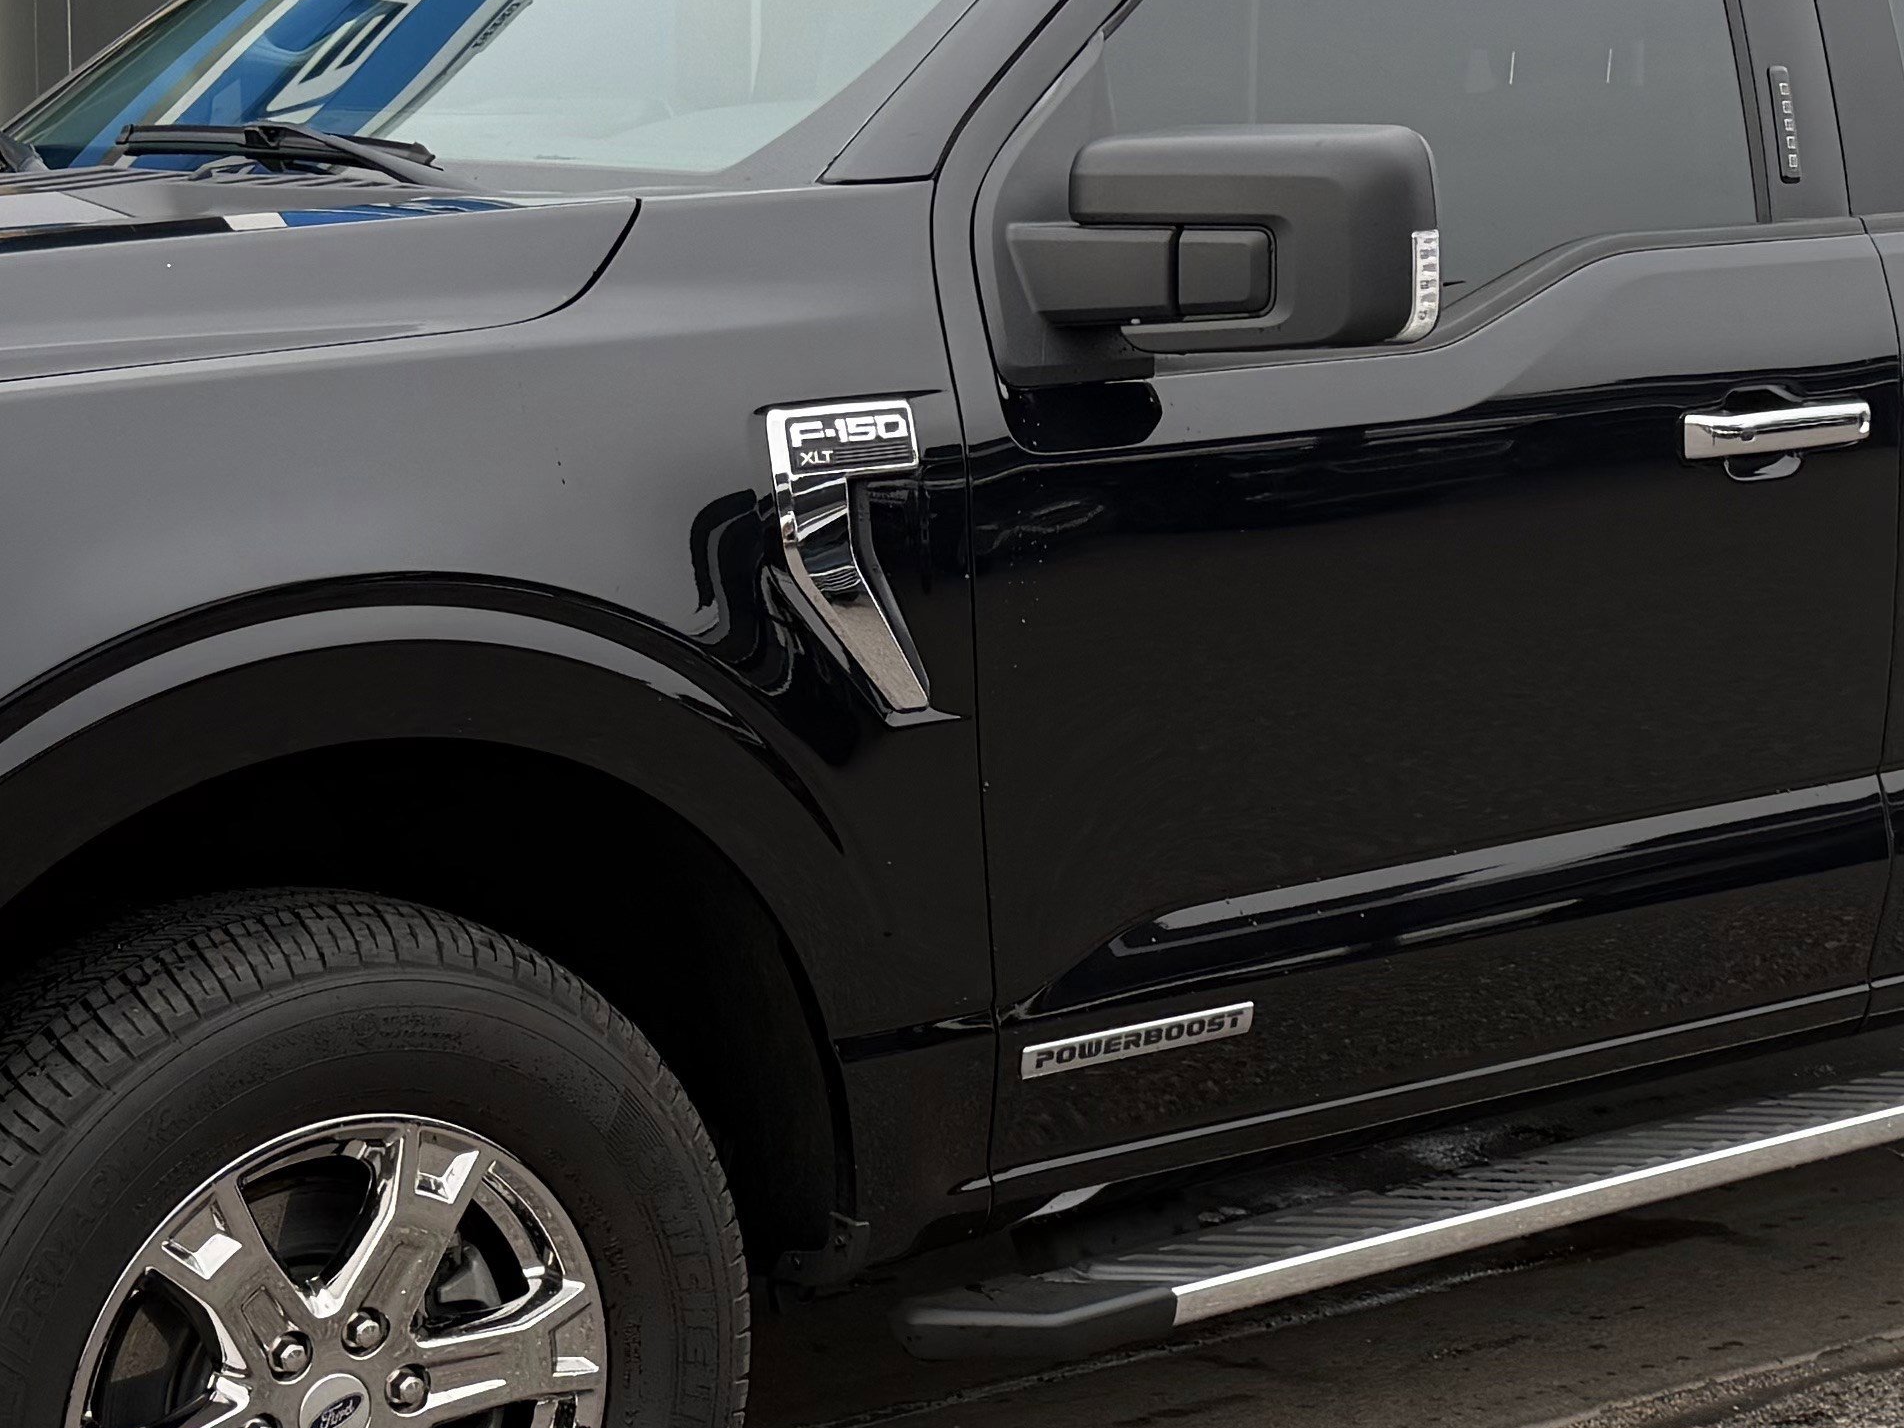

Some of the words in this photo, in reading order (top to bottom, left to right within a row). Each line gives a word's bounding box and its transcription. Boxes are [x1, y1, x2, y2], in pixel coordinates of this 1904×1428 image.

[789, 413, 909, 448] F-150
[799, 449, 834, 467] XLT
[1034, 1010, 1245, 1069] POWERBOOST
